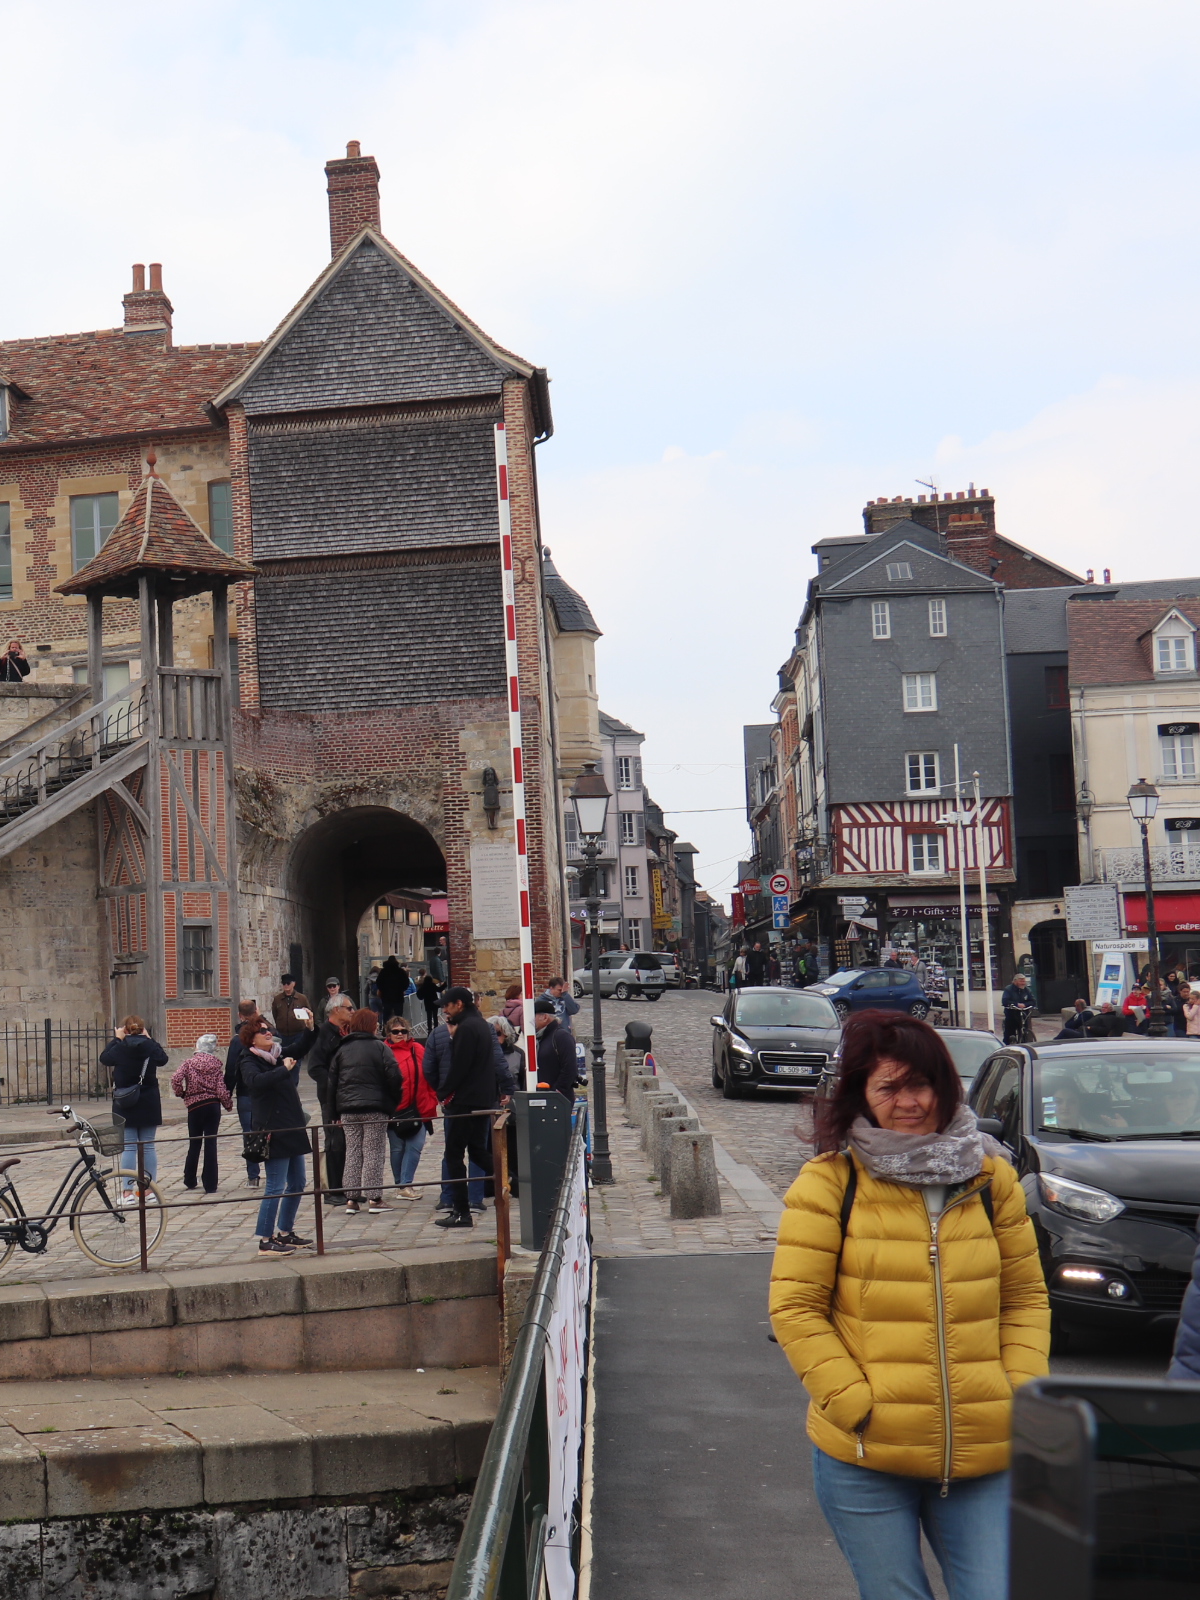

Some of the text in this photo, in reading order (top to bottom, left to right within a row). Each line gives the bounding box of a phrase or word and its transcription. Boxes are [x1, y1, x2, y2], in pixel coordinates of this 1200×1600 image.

[892, 908, 917, 916] ギフト
[923, 907, 944, 916] Gifts
[974, 906, 999, 914] relos
[1095, 942, 1135, 950] Naturospace
